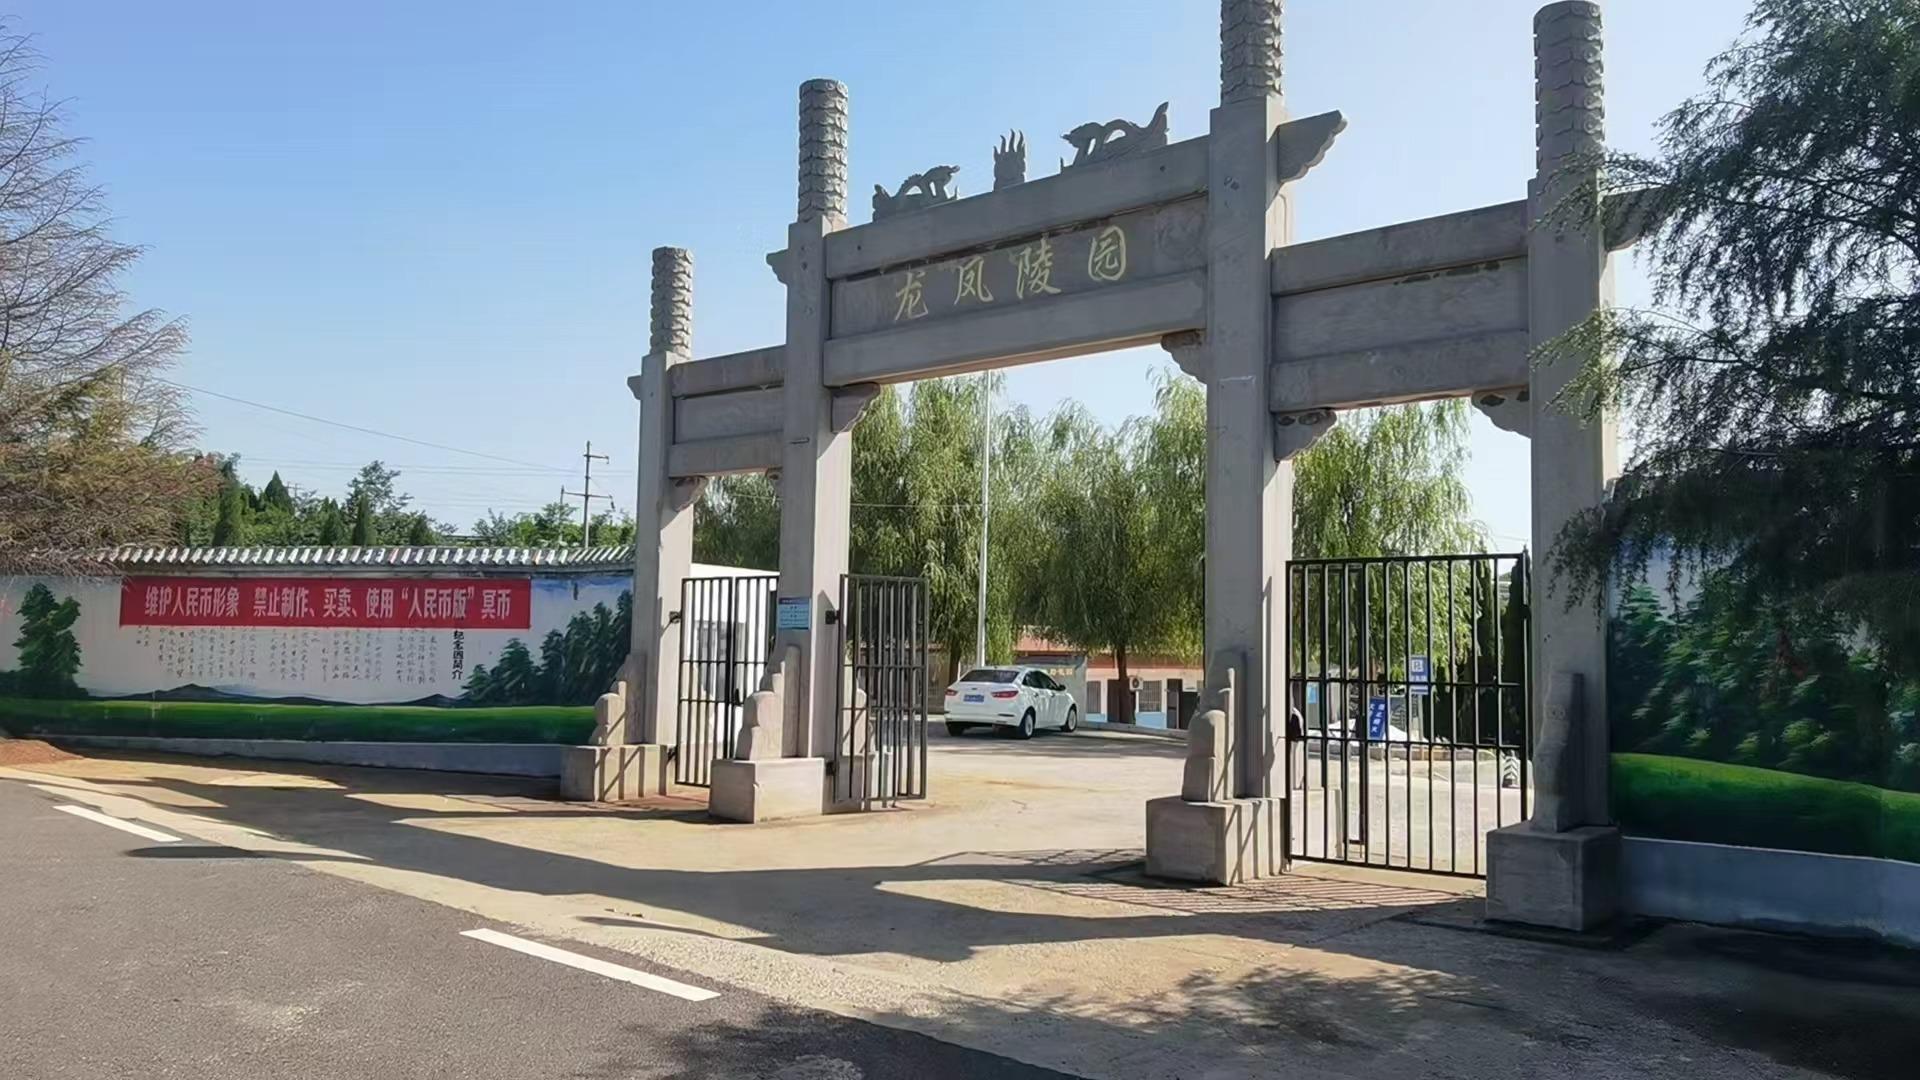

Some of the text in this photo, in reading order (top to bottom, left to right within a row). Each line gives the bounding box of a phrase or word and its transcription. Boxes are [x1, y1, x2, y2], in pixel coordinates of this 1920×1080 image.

[895, 225, 1127, 321] 龙凤陵园
[145, 586, 240, 618] 维护人民币形象
